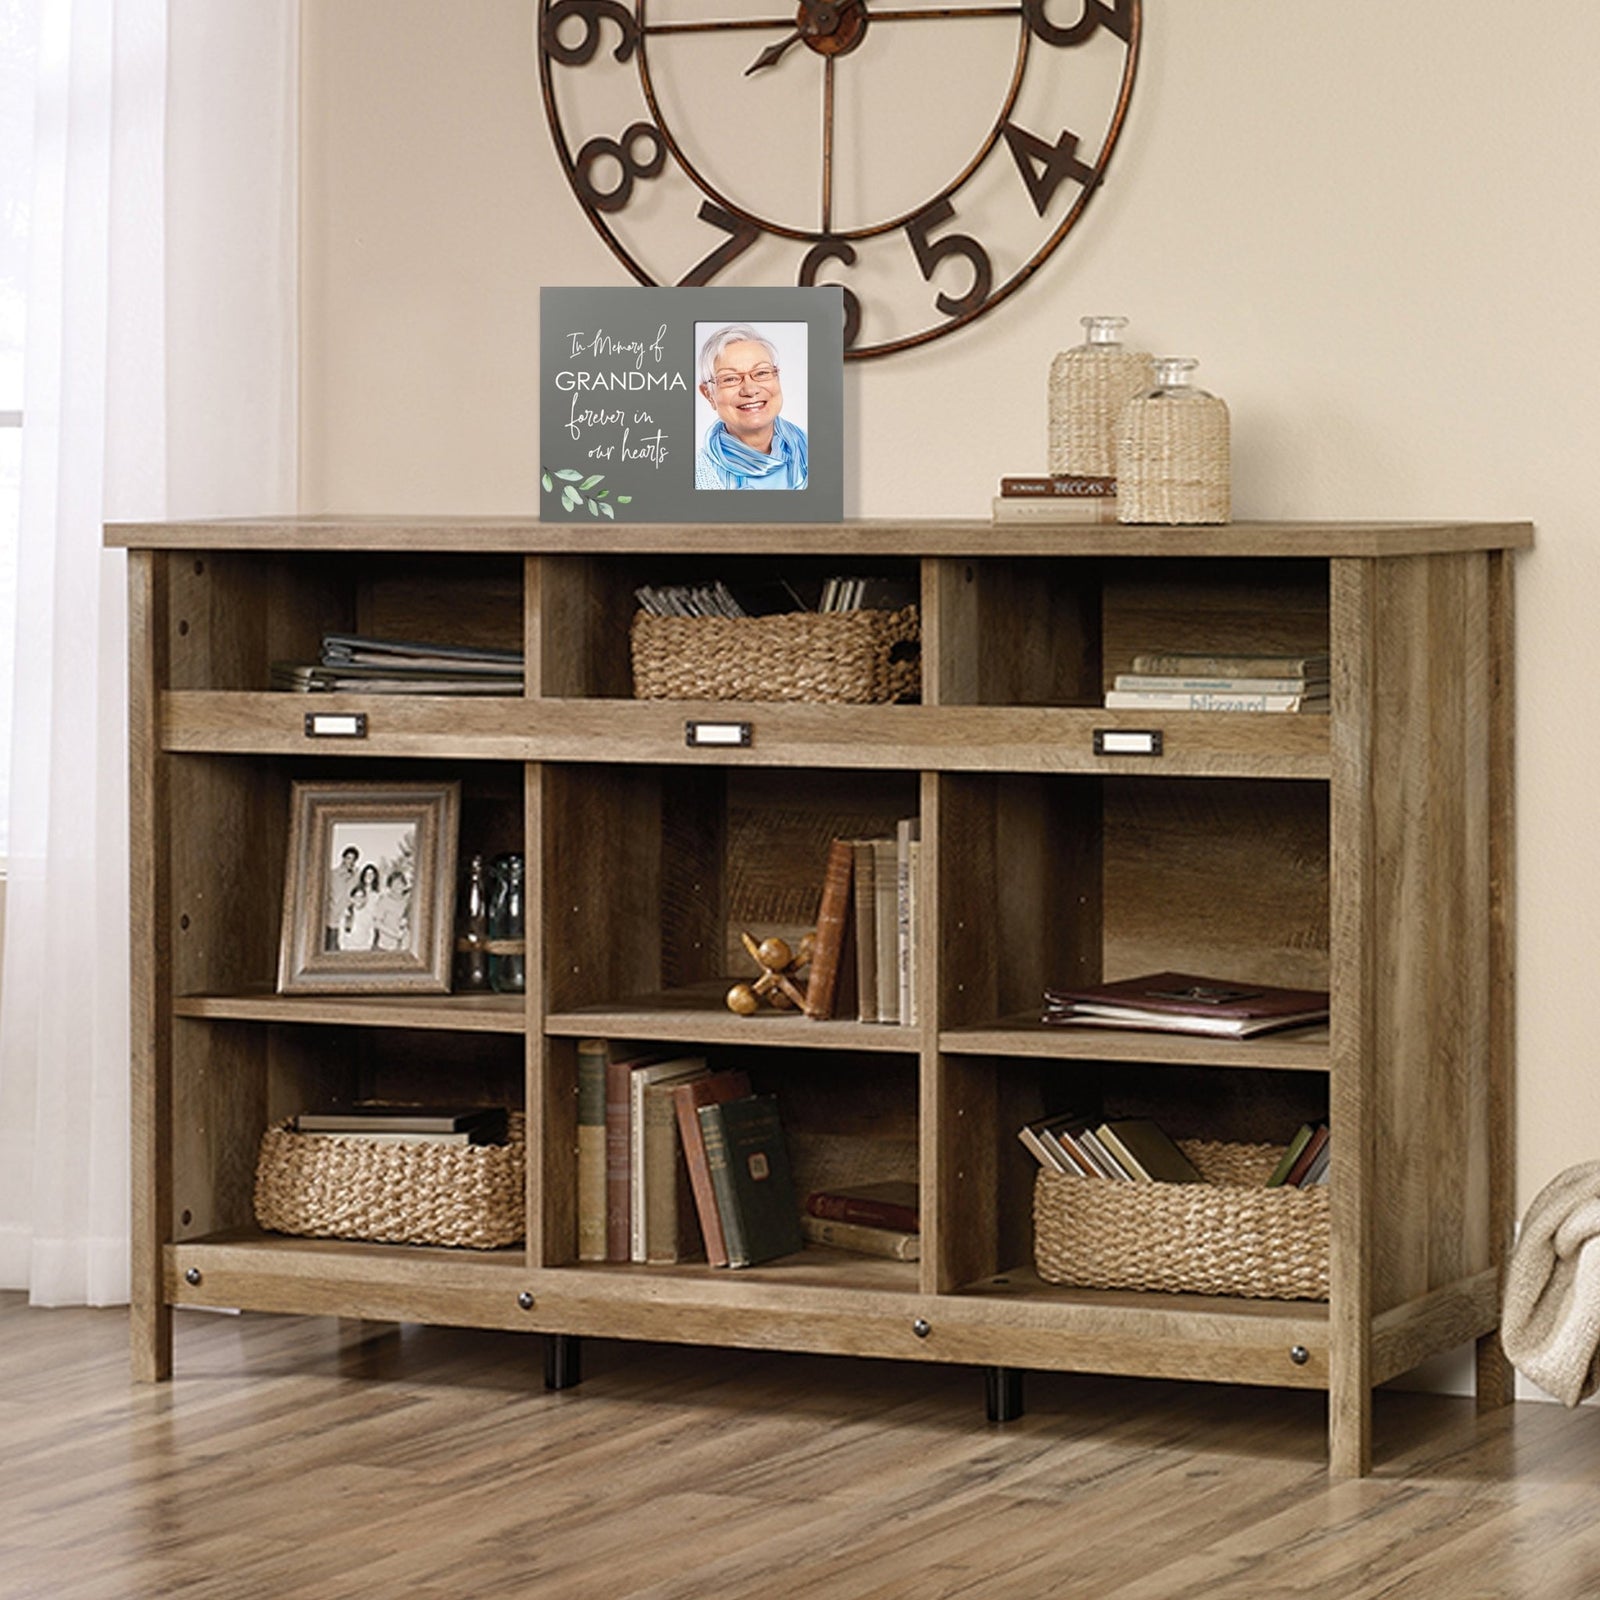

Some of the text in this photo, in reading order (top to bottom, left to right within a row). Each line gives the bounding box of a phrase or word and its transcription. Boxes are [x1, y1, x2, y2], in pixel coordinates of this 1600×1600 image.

[547, 0, 637, 67] 9
[574, 121, 668, 215] 8
[999, 118, 1102, 218] 4
[672, 199, 762, 288] 7
[904, 199, 992, 318] 5
[566, 323, 668, 370] In Memory of
[555, 371, 688, 391] GRANDMA
[564, 392, 655, 441] forever in
[588, 427, 670, 470] our hearts
[1189, 694, 1267, 714] blizzard
